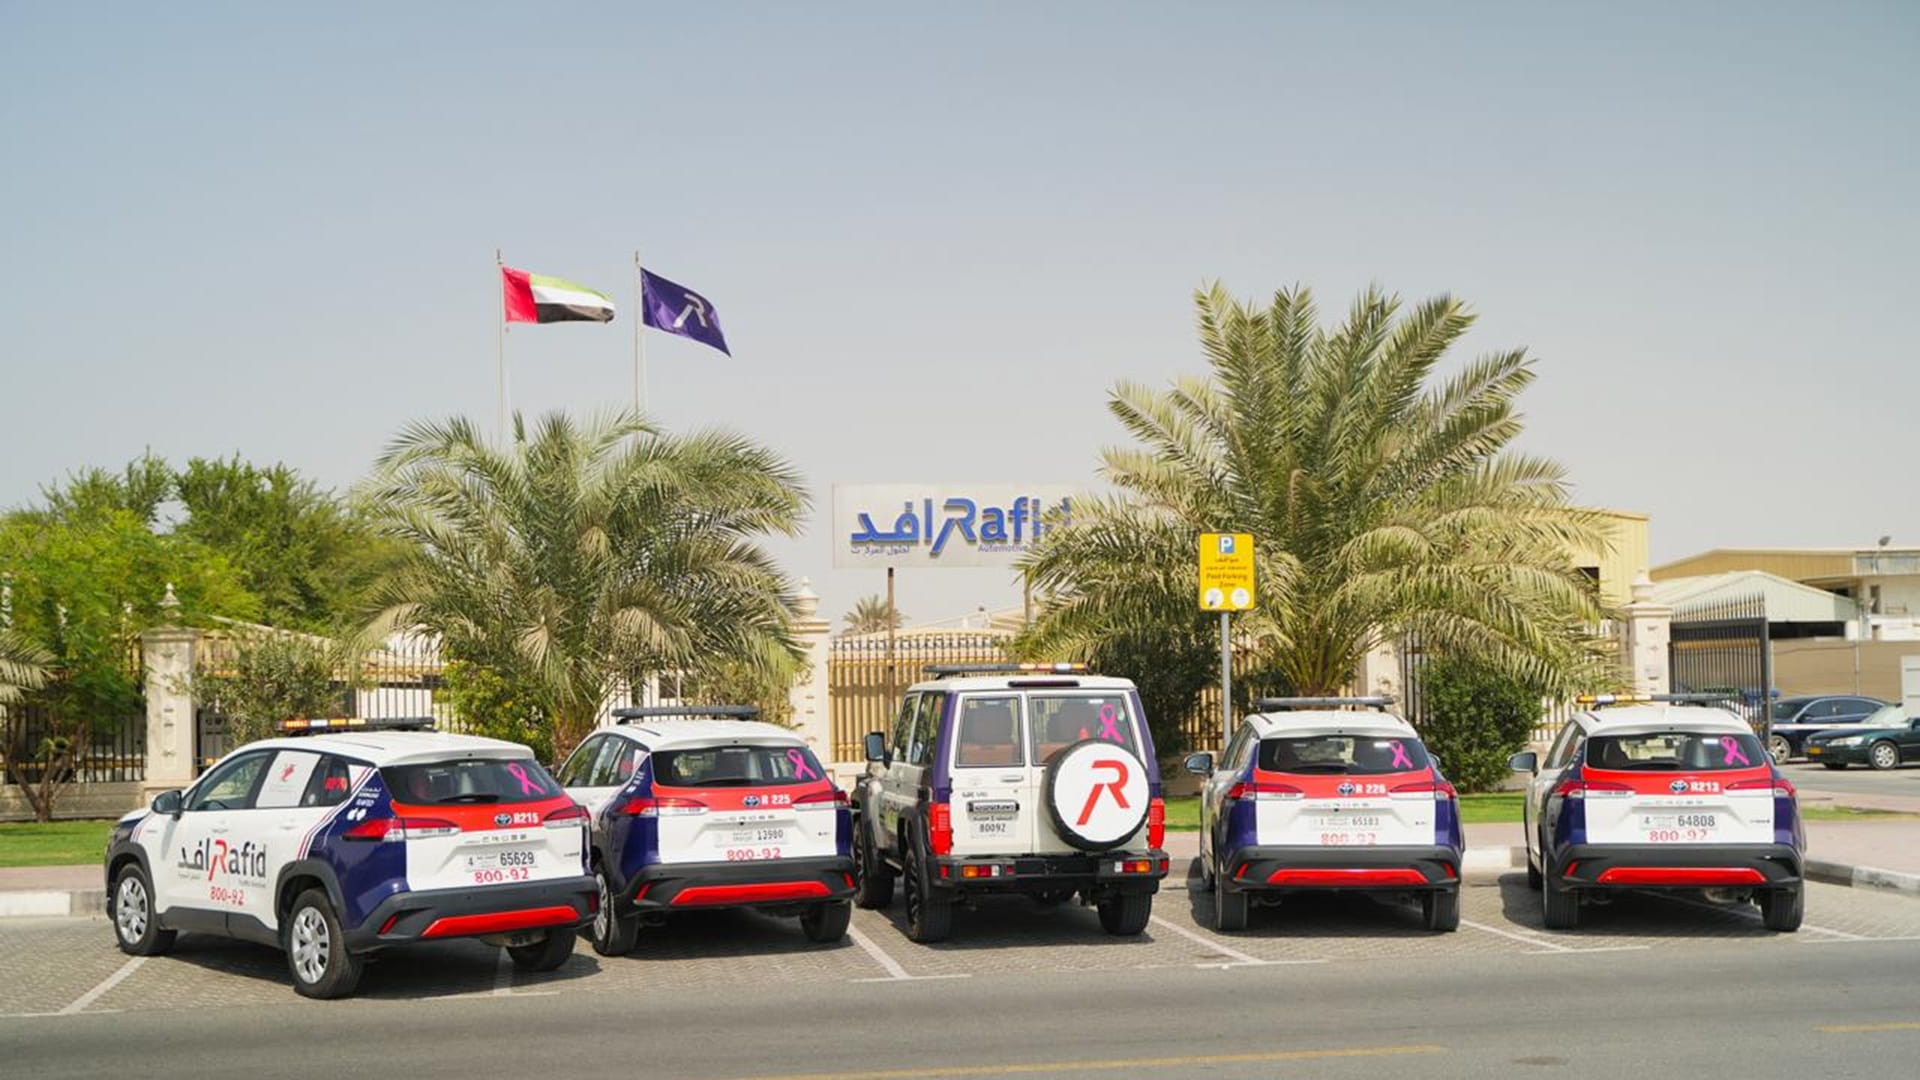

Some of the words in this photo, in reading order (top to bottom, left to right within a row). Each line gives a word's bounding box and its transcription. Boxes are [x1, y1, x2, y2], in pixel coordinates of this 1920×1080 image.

[1222, 573, 1248, 582] Parking
[1076, 760, 1130, 825] R
[513, 812, 539, 824] R215
[1678, 815, 1715, 827] 64808
[208, 840, 266, 881] Rafid
[500, 851, 535, 866] 65629
[727, 848, 781, 861] 800-92
[474, 867, 529, 883] 800-92
